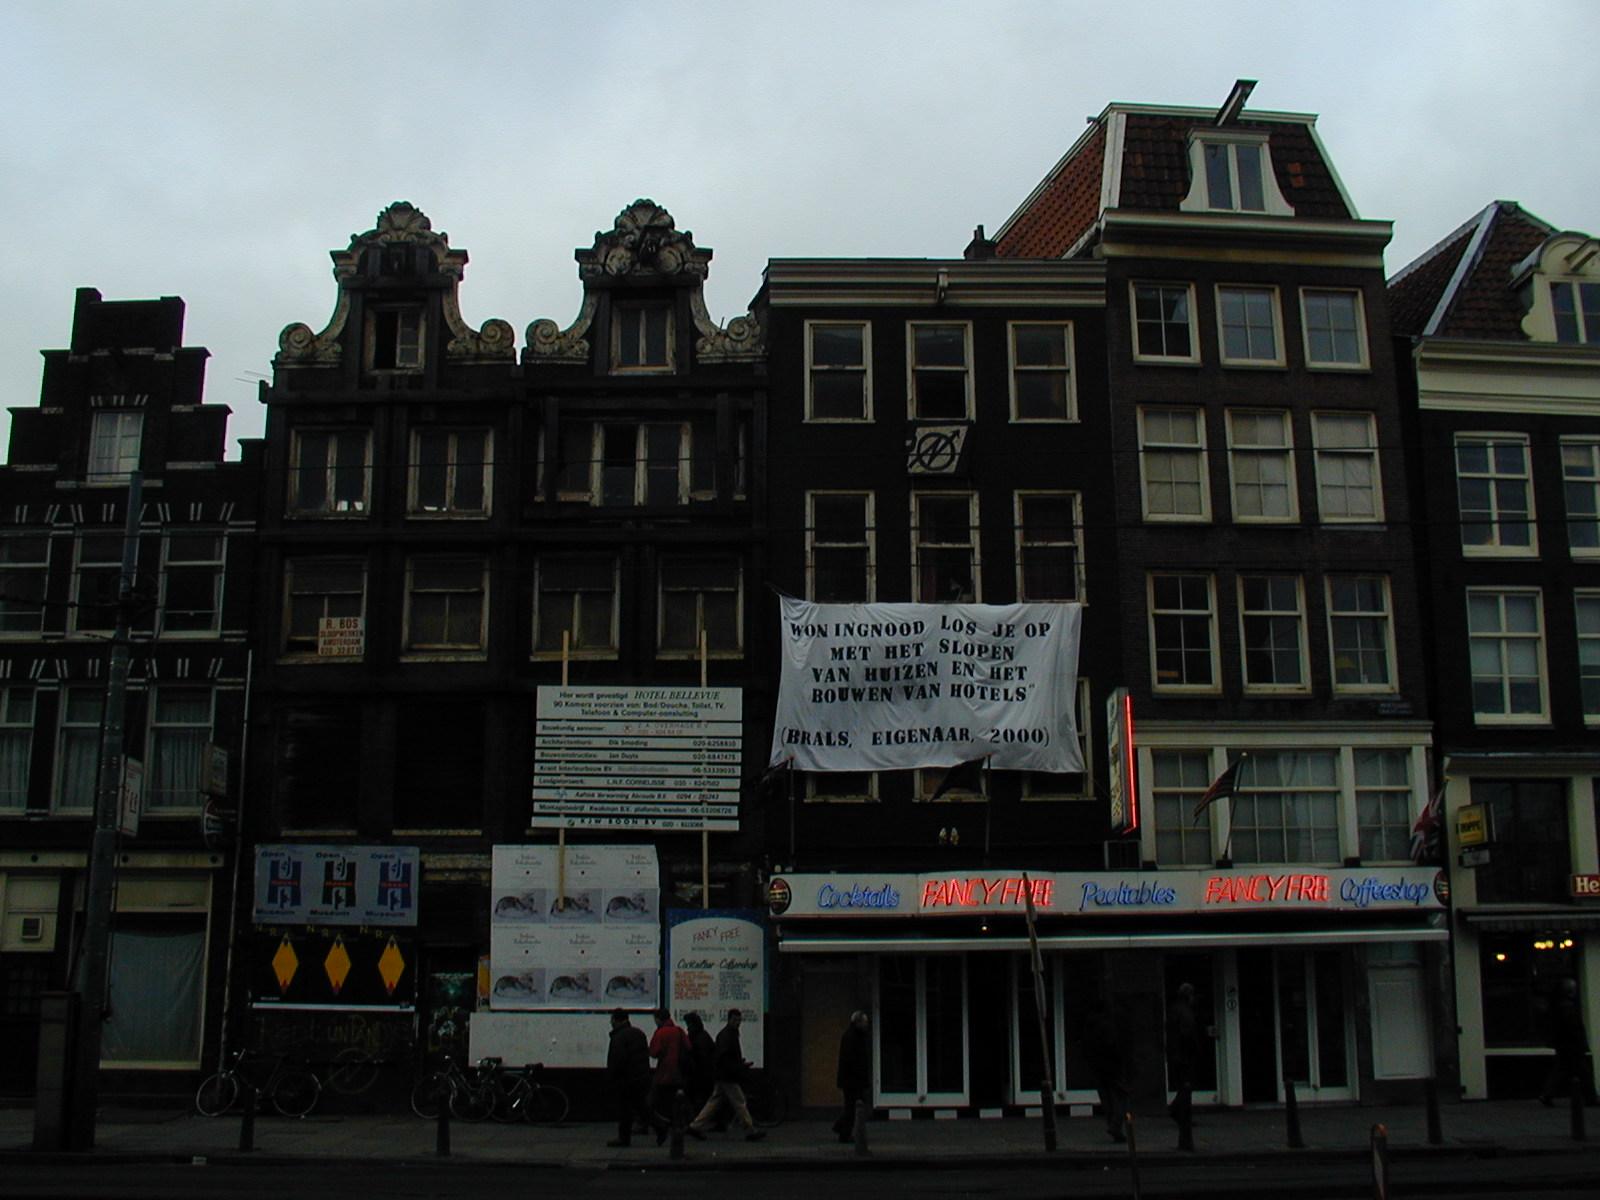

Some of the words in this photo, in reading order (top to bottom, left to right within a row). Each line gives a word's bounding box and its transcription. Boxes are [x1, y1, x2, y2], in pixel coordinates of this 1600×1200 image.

[339, 618, 358, 629] BOS
[941, 615, 977, 635] LOS
[992, 623, 1015, 638] JE
[1025, 622, 1050, 637] OP
[830, 646, 871, 660] MET
[885, 642, 924, 659] HET
[940, 639, 1015, 660] SLOPEN
[812, 667, 850, 682] VAN
[865, 661, 938, 681] HUIZEN
[952, 661, 975, 677] EN
[990, 666, 1027, 680] HET
[634, 691, 667, 700] HOTEL
[669, 691, 720, 700] BELLEVUE
[812, 686, 893, 703] BOUWEN
[904, 683, 940, 700] VAN
[781, 727, 852, 748] (BRALS,
[872, 726, 975, 743] EIGENAAR,
[990, 726, 1050, 748] 2000)
[819, 882, 899, 908] Cocktails
[923, 878, 1001, 907] FANCY
[1079, 880, 1176, 911] Pooltables
[1206, 874, 1283, 904] FANCY
[1284, 874, 1330, 901] FREE
[1340, 877, 1429, 908] Coffeeshop
